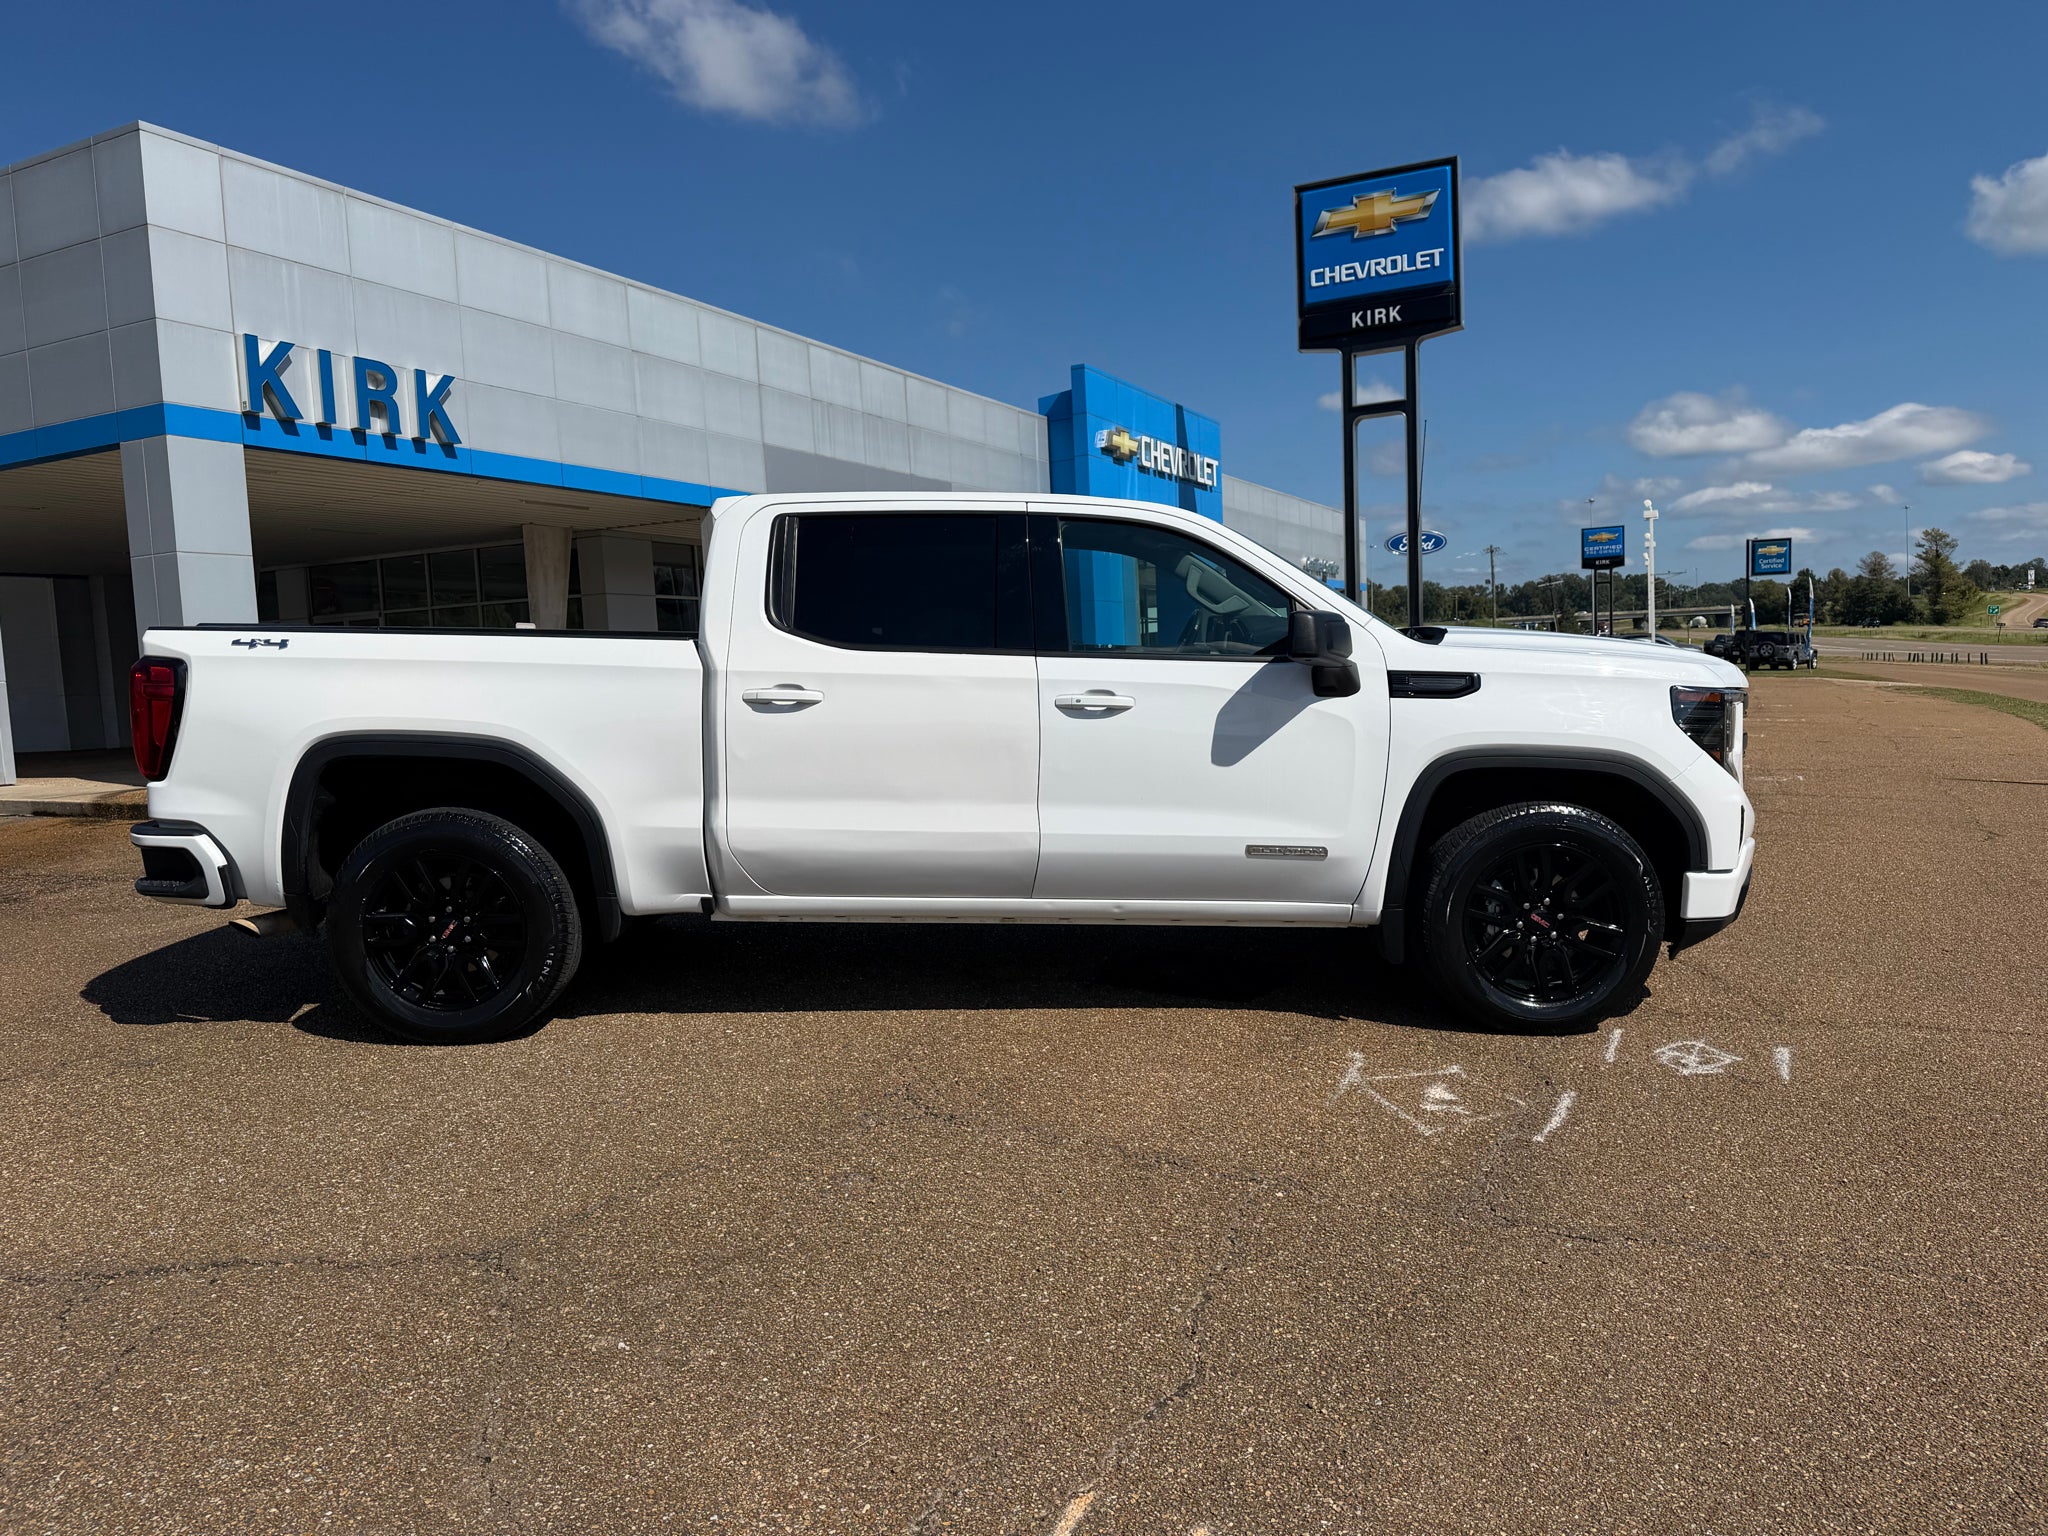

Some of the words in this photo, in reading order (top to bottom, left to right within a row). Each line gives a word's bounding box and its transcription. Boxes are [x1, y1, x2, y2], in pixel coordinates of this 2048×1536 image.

[1310, 248, 1445, 287] CHEVROLET
[1351, 305, 1403, 329] KIRK
[243, 333, 463, 445] KIRK
[1140, 435, 1219, 487] CHEVROLET
[1530, 913, 1551, 929] GMC
